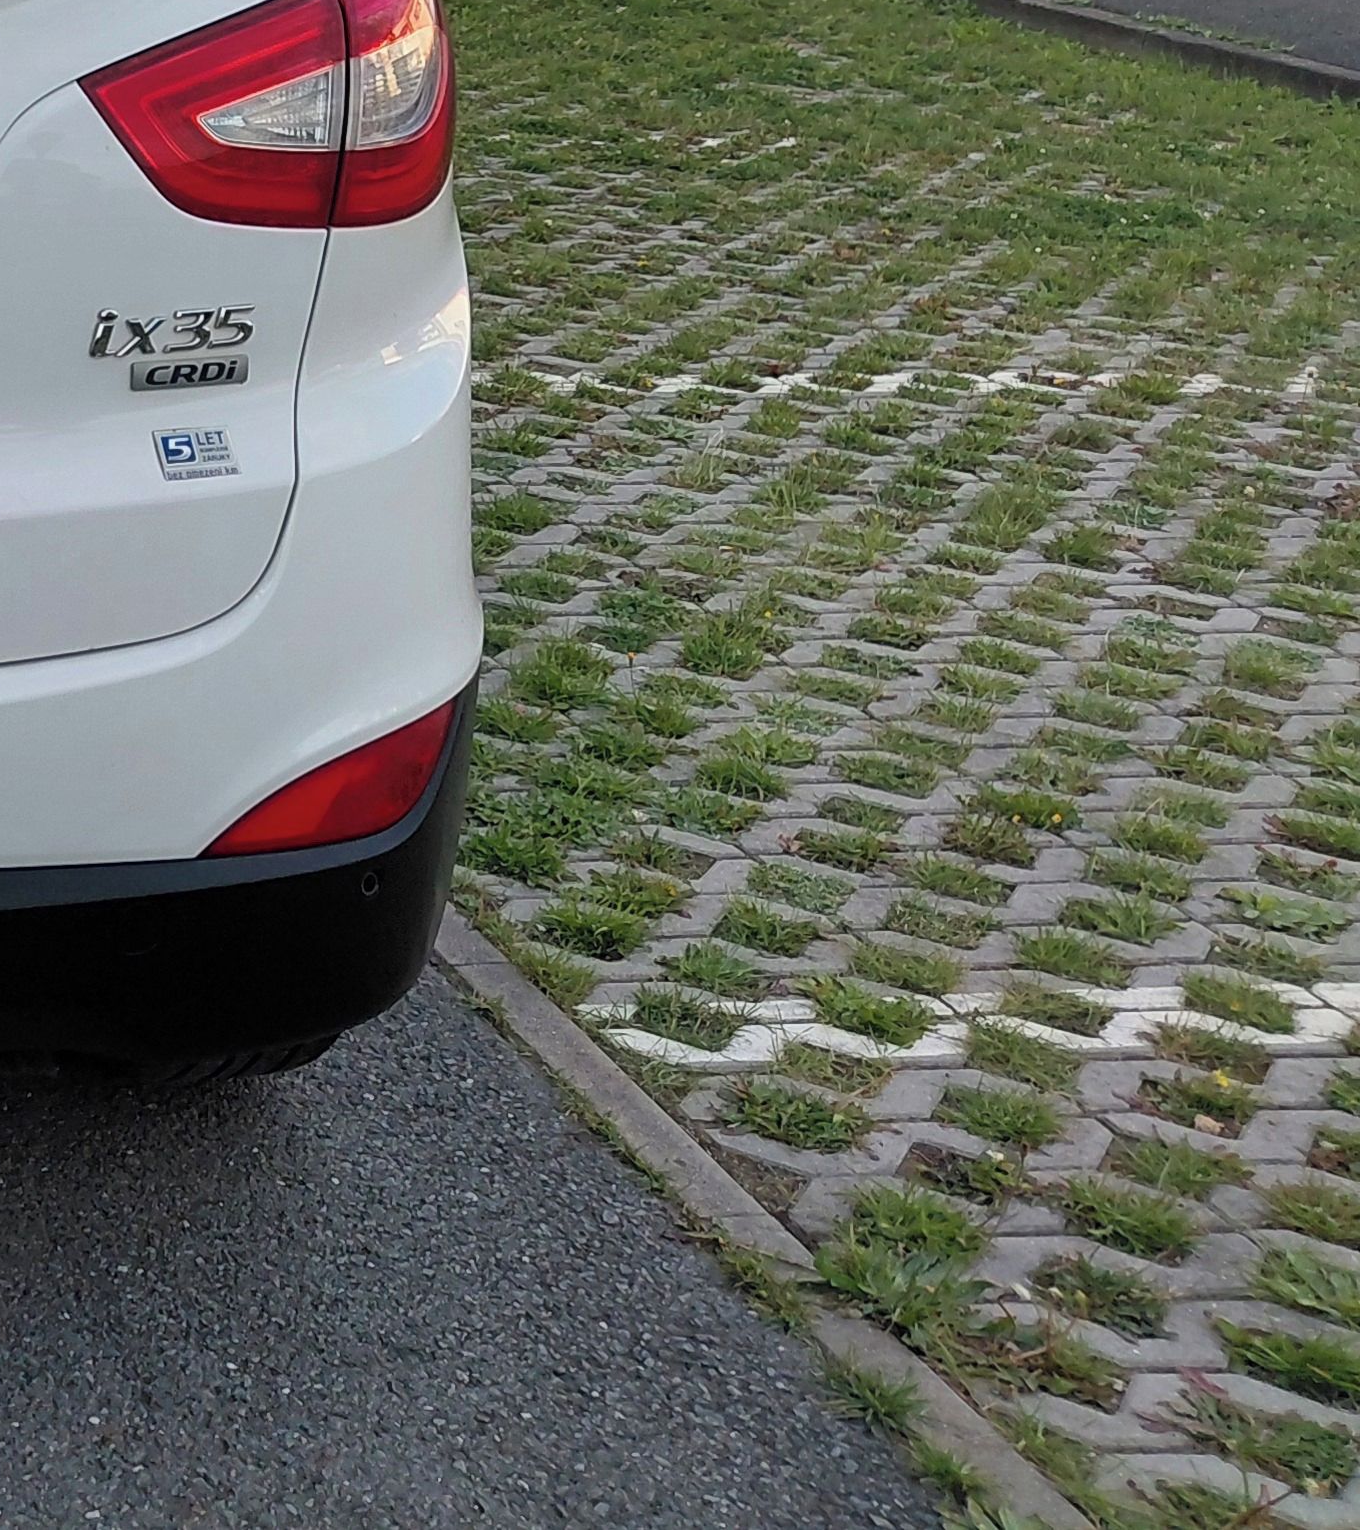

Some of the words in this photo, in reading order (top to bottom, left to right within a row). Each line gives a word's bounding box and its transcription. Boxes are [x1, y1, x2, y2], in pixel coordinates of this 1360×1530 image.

[88, 303, 257, 359] ix35
[144, 360, 239, 386] CRDi
[168, 437, 192, 461] 5
[195, 430, 224, 446] LET
